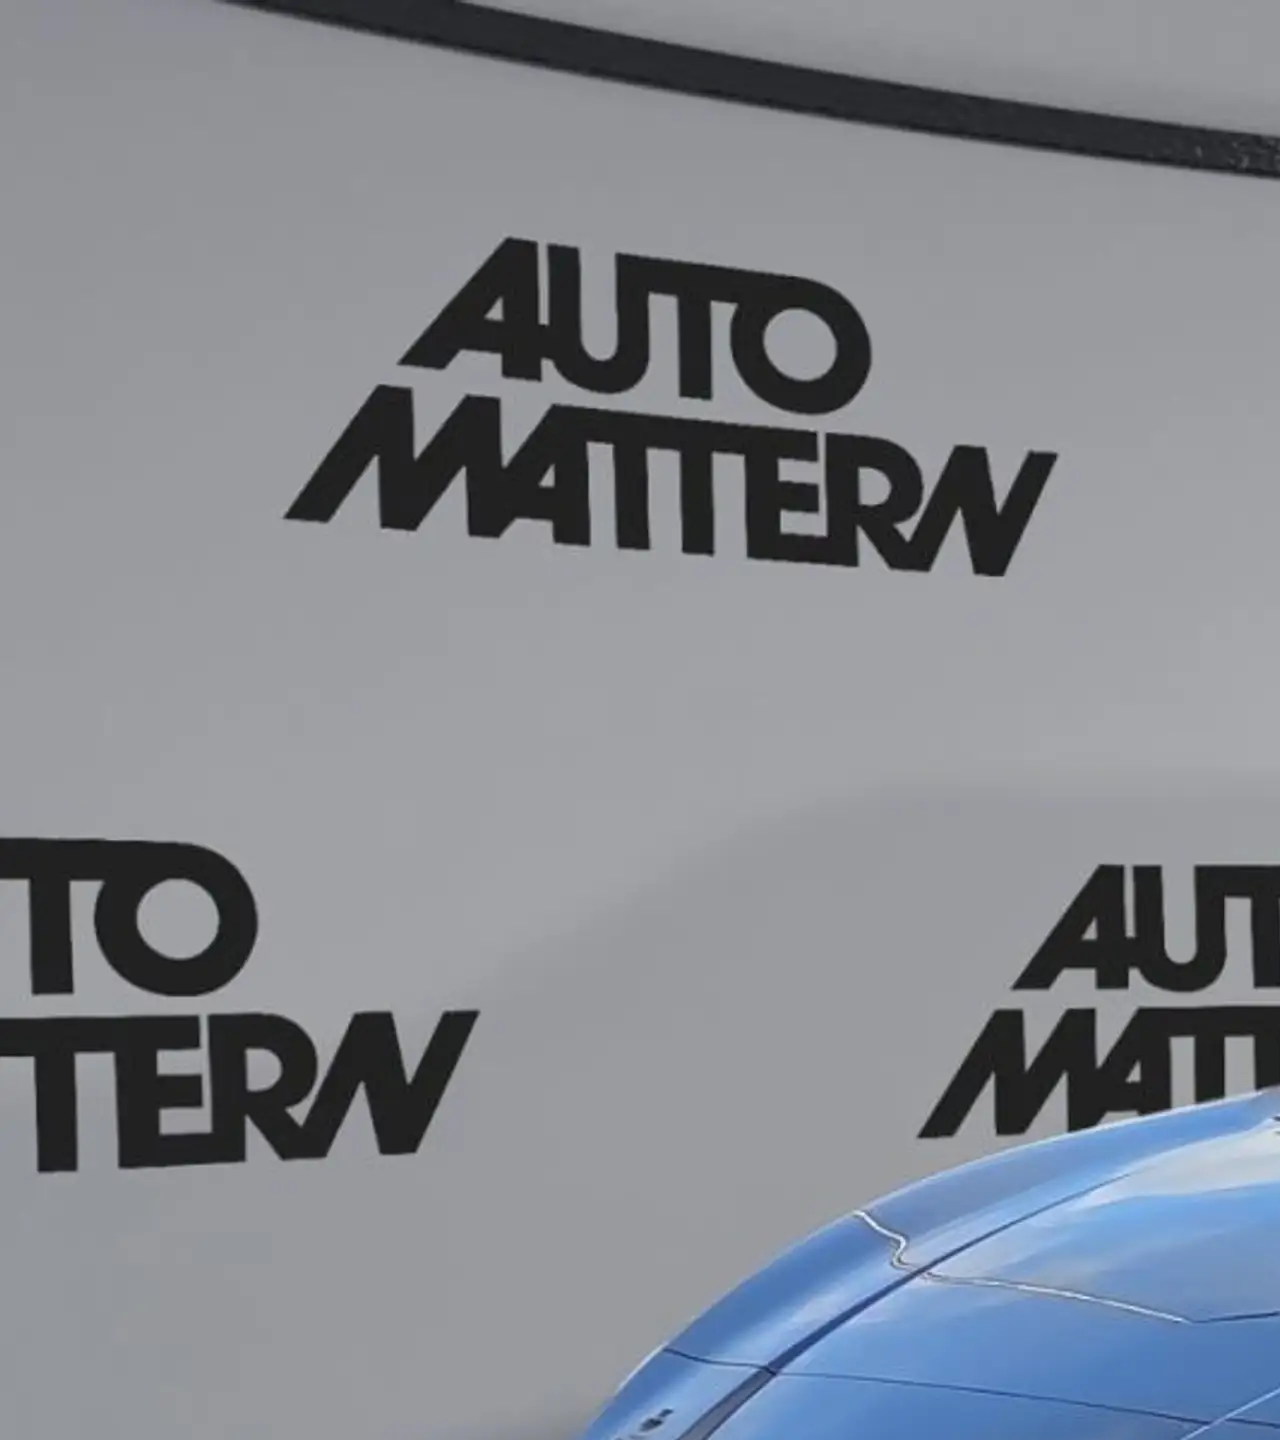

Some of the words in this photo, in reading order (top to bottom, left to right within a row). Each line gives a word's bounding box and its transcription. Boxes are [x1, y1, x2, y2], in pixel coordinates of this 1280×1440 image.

[398, 237, 873, 416] AUTO
[284, 384, 1058, 578] MATTERN
[0, 837, 258, 997] TO
[0, 1010, 480, 1173] TERN
